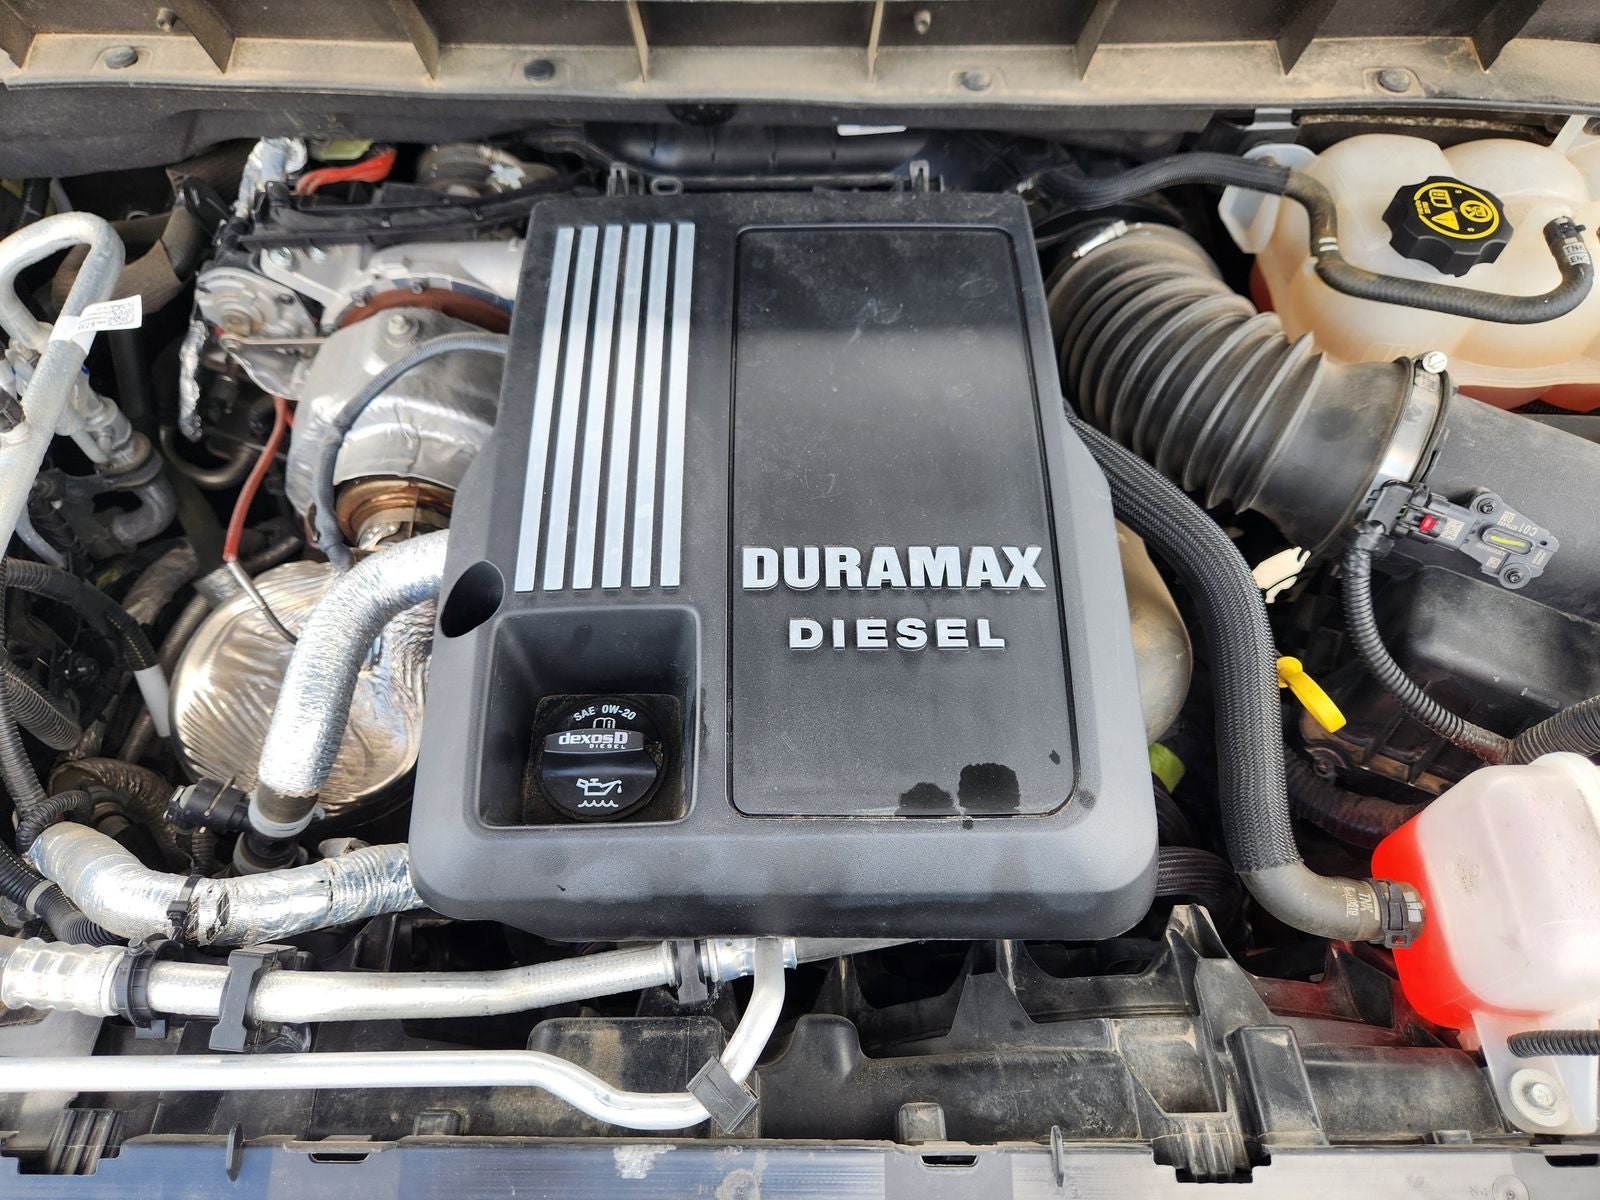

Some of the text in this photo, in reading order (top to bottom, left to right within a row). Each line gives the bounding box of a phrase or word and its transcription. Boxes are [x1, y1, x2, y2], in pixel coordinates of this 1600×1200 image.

[742, 546, 1047, 590] DURAMAX
[788, 618, 1006, 650] DIESEL
[573, 704, 637, 721] SAE 0W-20
